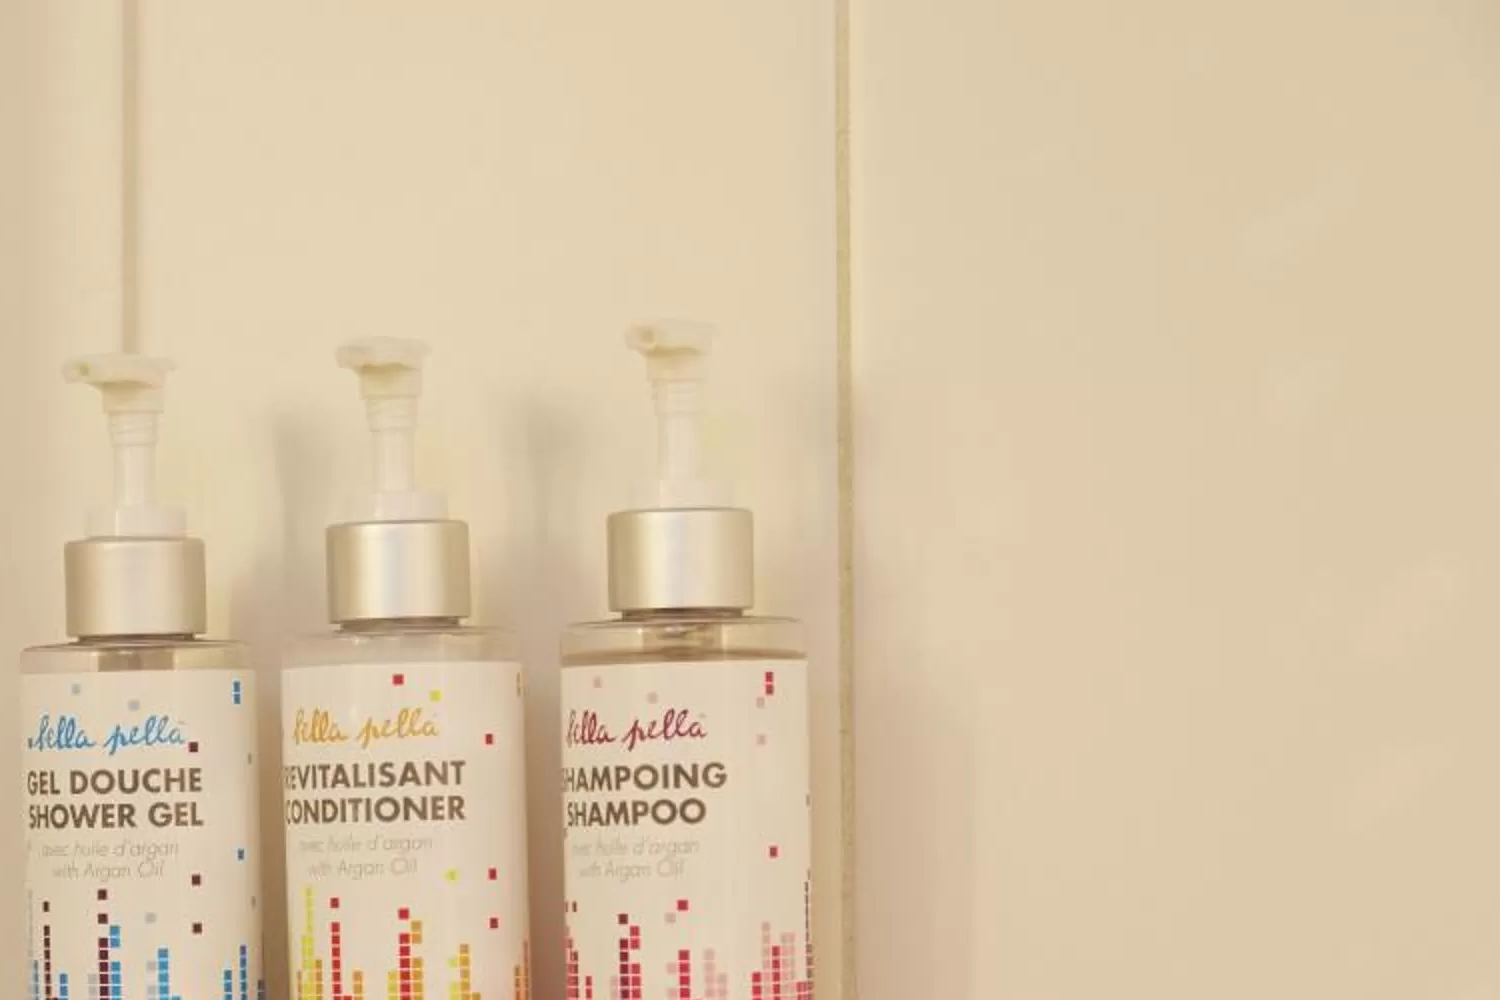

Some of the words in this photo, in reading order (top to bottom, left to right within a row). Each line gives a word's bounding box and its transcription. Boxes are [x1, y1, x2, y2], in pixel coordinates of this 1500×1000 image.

[102, 714, 186, 756] pella
[621, 708, 708, 752] pella
[27, 770, 61, 797] GEL
[69, 767, 203, 795] DOUCHE
[29, 803, 137, 830] SHOWER
[148, 801, 205, 828] GEL
[285, 796, 467, 825] CONDITIONER
[567, 798, 707, 828] SHAMPOO
